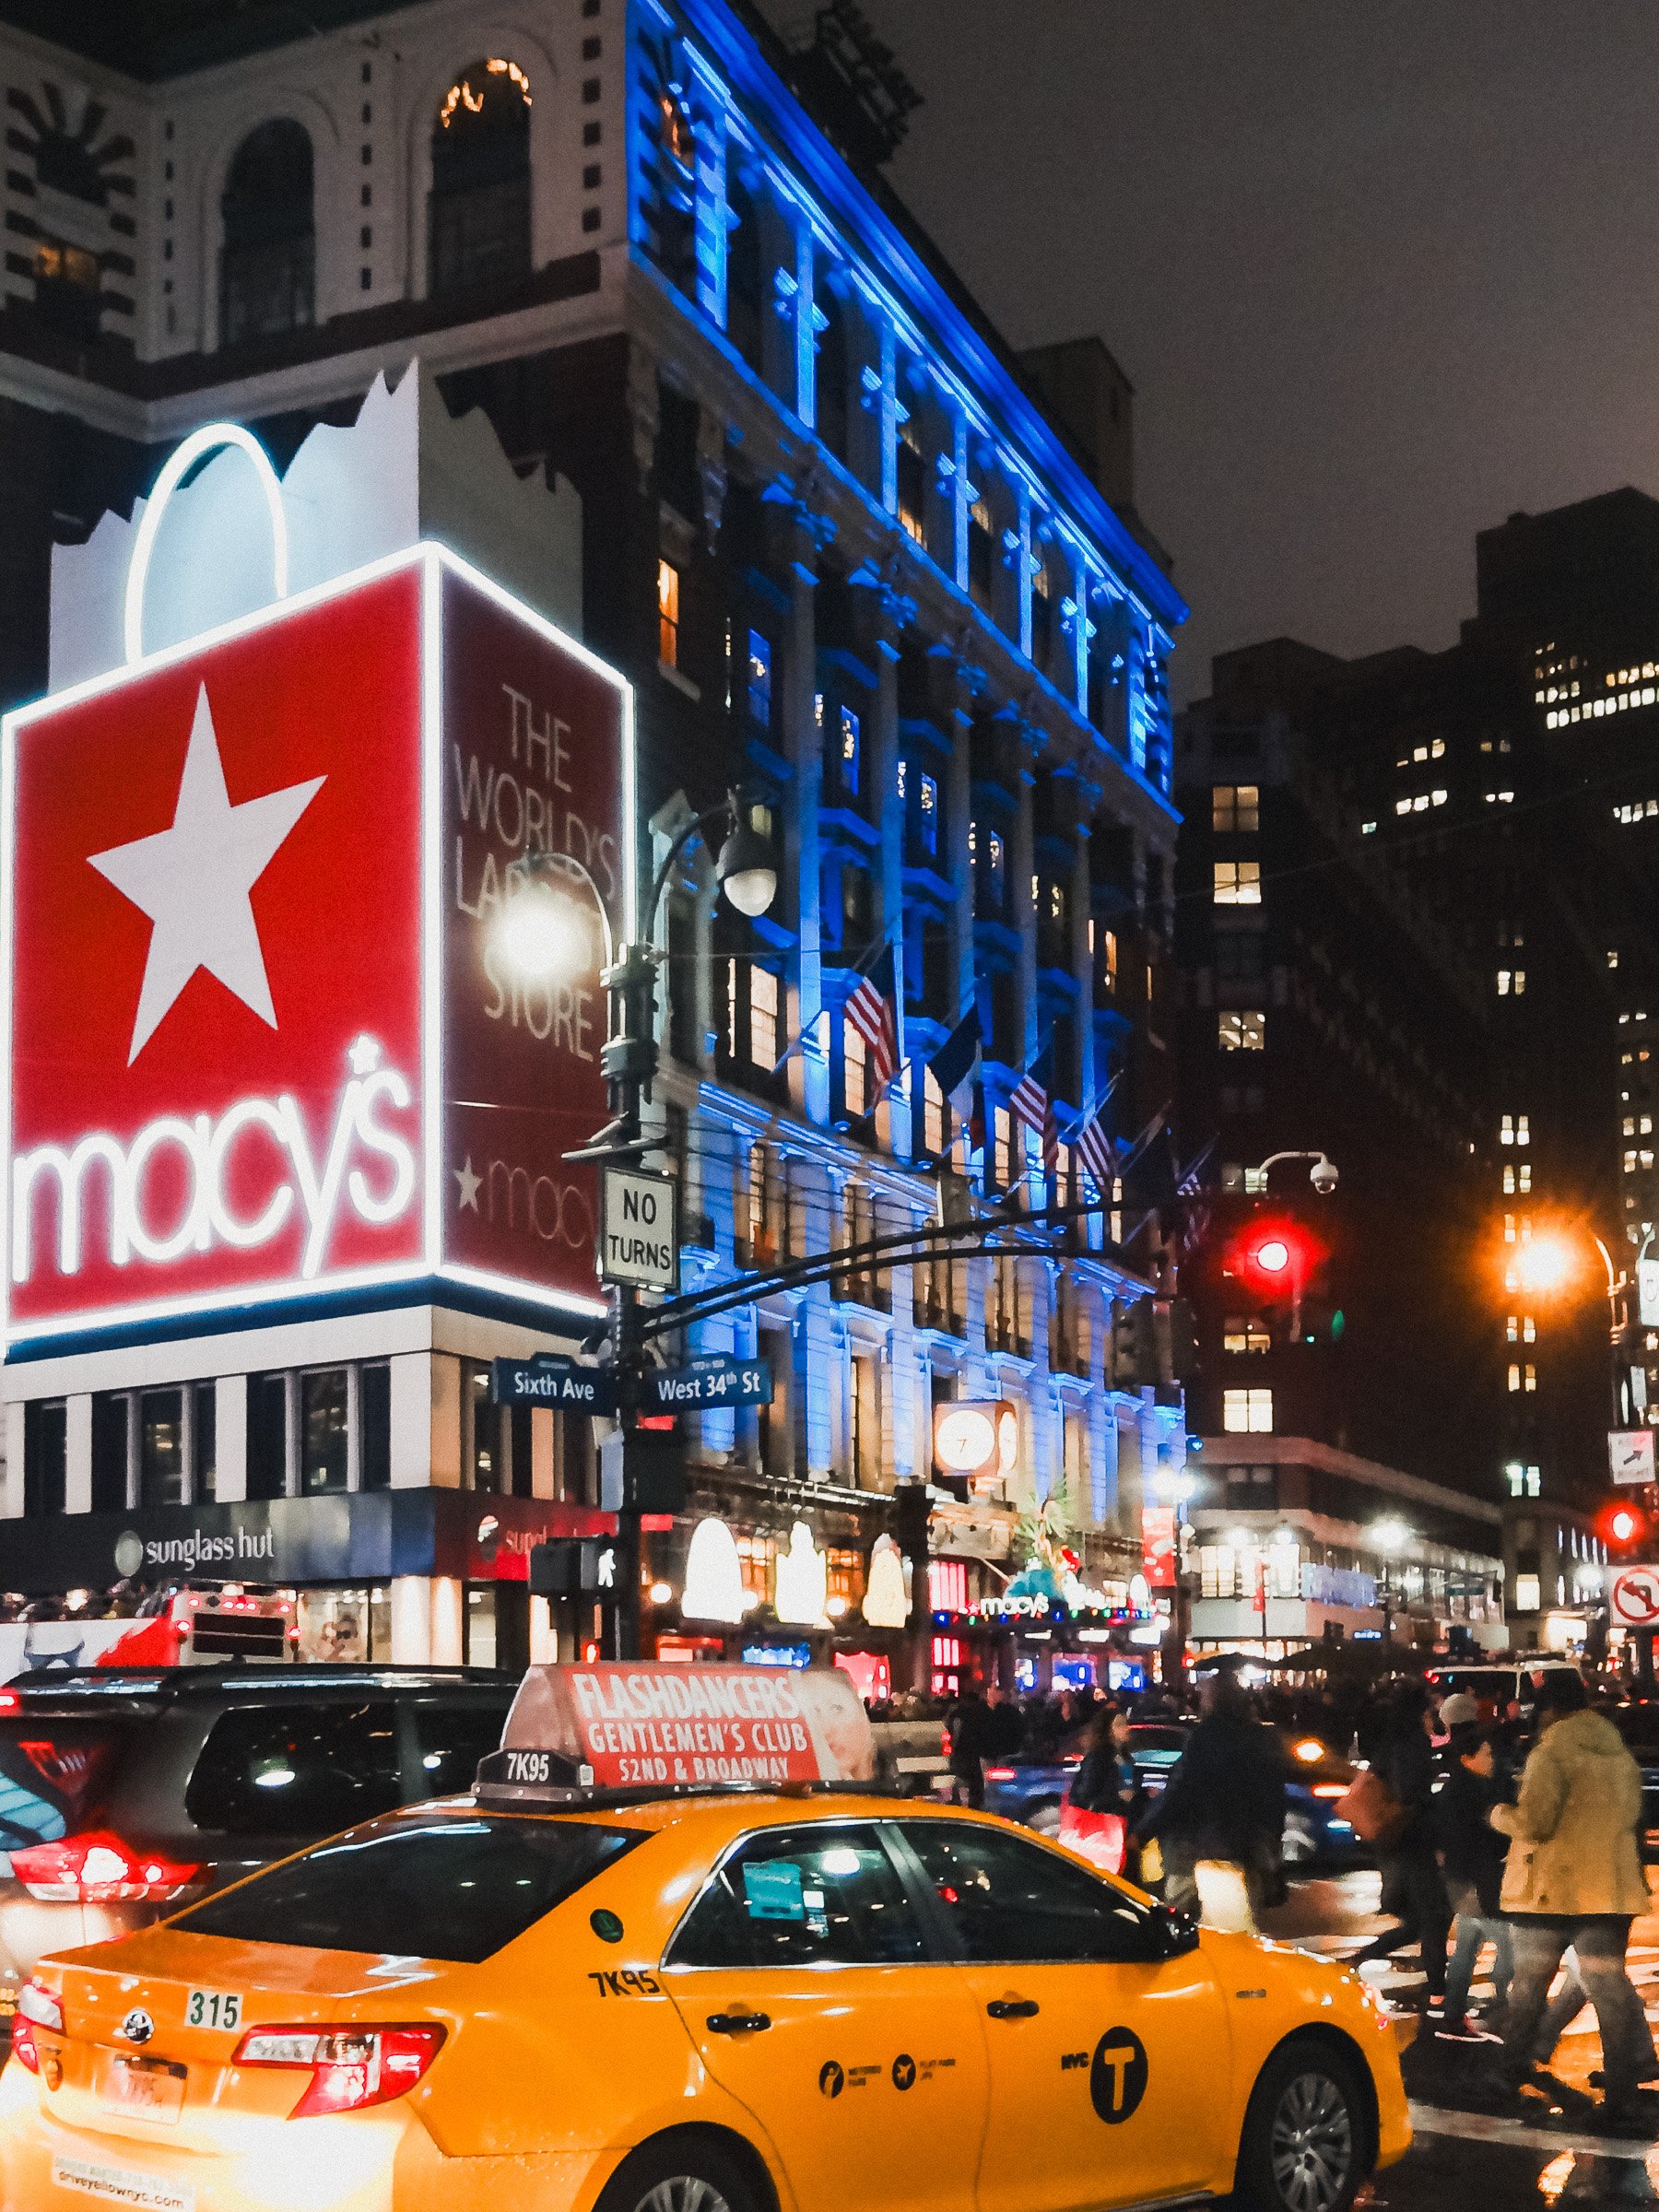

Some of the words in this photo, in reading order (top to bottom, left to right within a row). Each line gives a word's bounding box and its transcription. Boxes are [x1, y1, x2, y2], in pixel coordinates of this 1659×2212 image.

[502, 683, 571, 793] THE
[11, 1034, 415, 1283] macy's
[623, 1188, 657, 1226] NO
[608, 1234, 672, 1271] TURNS
[514, 1371, 558, 1397] Sixth
[562, 1377, 594, 1401] Ave
[658, 1379, 701, 1402] West
[706, 1371, 737, 1397] 34th
[742, 1370, 760, 1394] St
[146, 1528, 235, 1572] sunglass
[238, 1525, 275, 1559] hut
[571, 1672, 800, 1720] FLASHDANCERS
[588, 1722, 746, 1754] GENTLEMEN'S
[751, 1722, 807, 1752] CLUB
[507, 1752, 550, 1783] 7K95
[674, 1757, 688, 1781] &
[693, 1756, 789, 1781] BROADWAY
[588, 1970, 661, 1998] 7K95
[190, 1991, 239, 2030] 315
[1061, 2052, 1089, 2071] NYC
[1103, 2046, 1135, 2112] T
